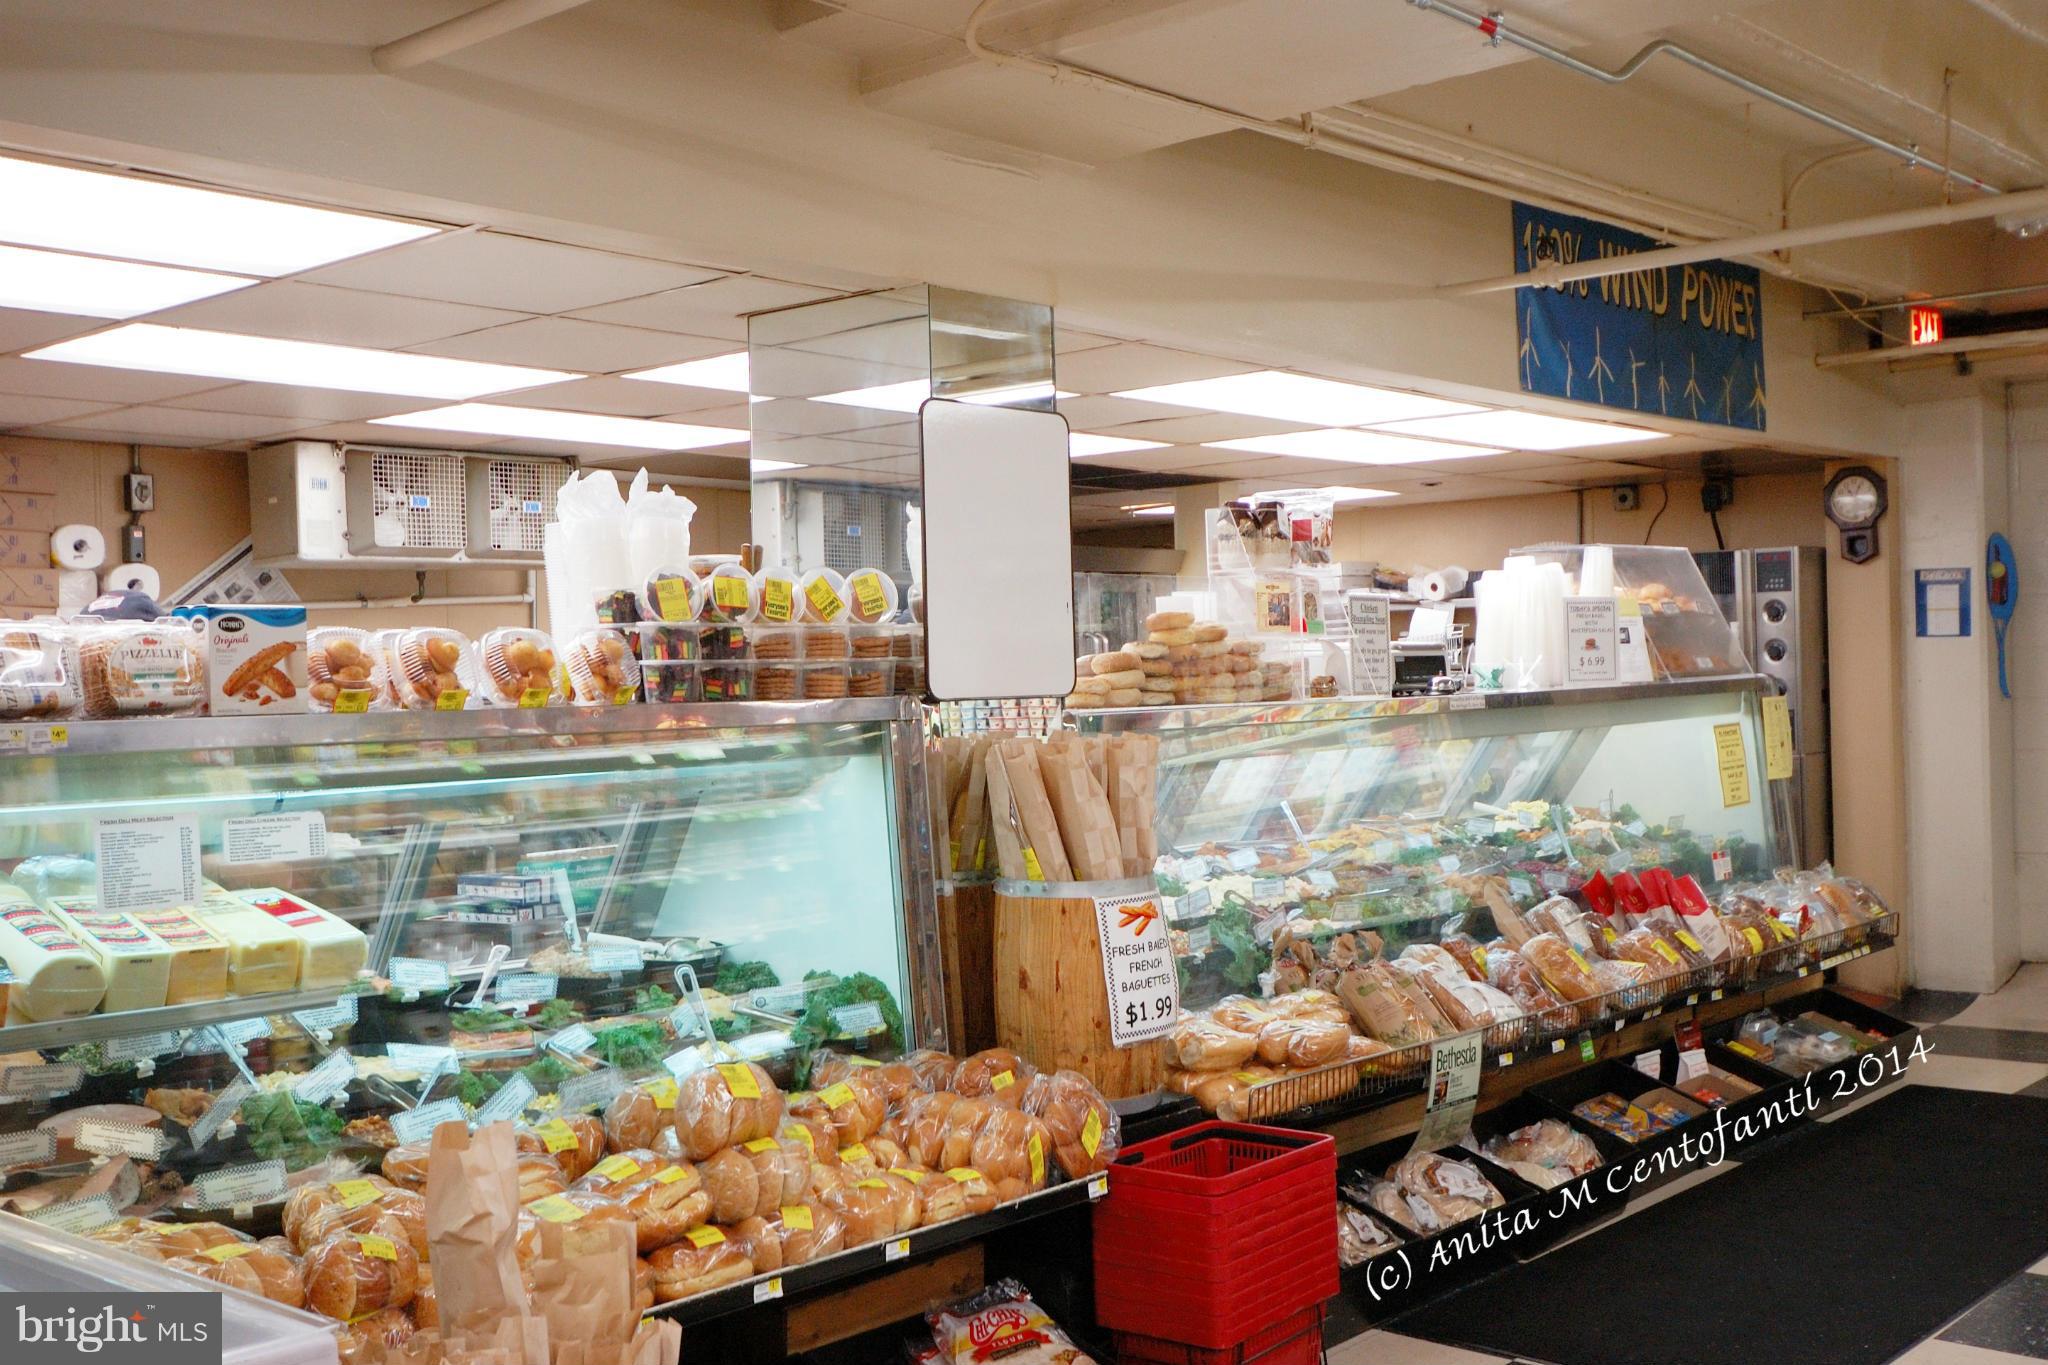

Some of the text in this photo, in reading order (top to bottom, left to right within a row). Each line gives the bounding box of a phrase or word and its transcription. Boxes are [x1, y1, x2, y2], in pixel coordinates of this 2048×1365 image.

[1681, 264, 1757, 339] POWER
[1911, 309, 1939, 345] EXIT
[121, 648, 183, 660] PIZZELLE
[1111, 938, 1168, 959] FRESH BAKED
[1129, 957, 1164, 974] FRENCH
[1121, 973, 1171, 993] BAGUETTES
[1125, 995, 1172, 1029] $1.99
[1436, 1041, 1477, 1073] Bethesda
